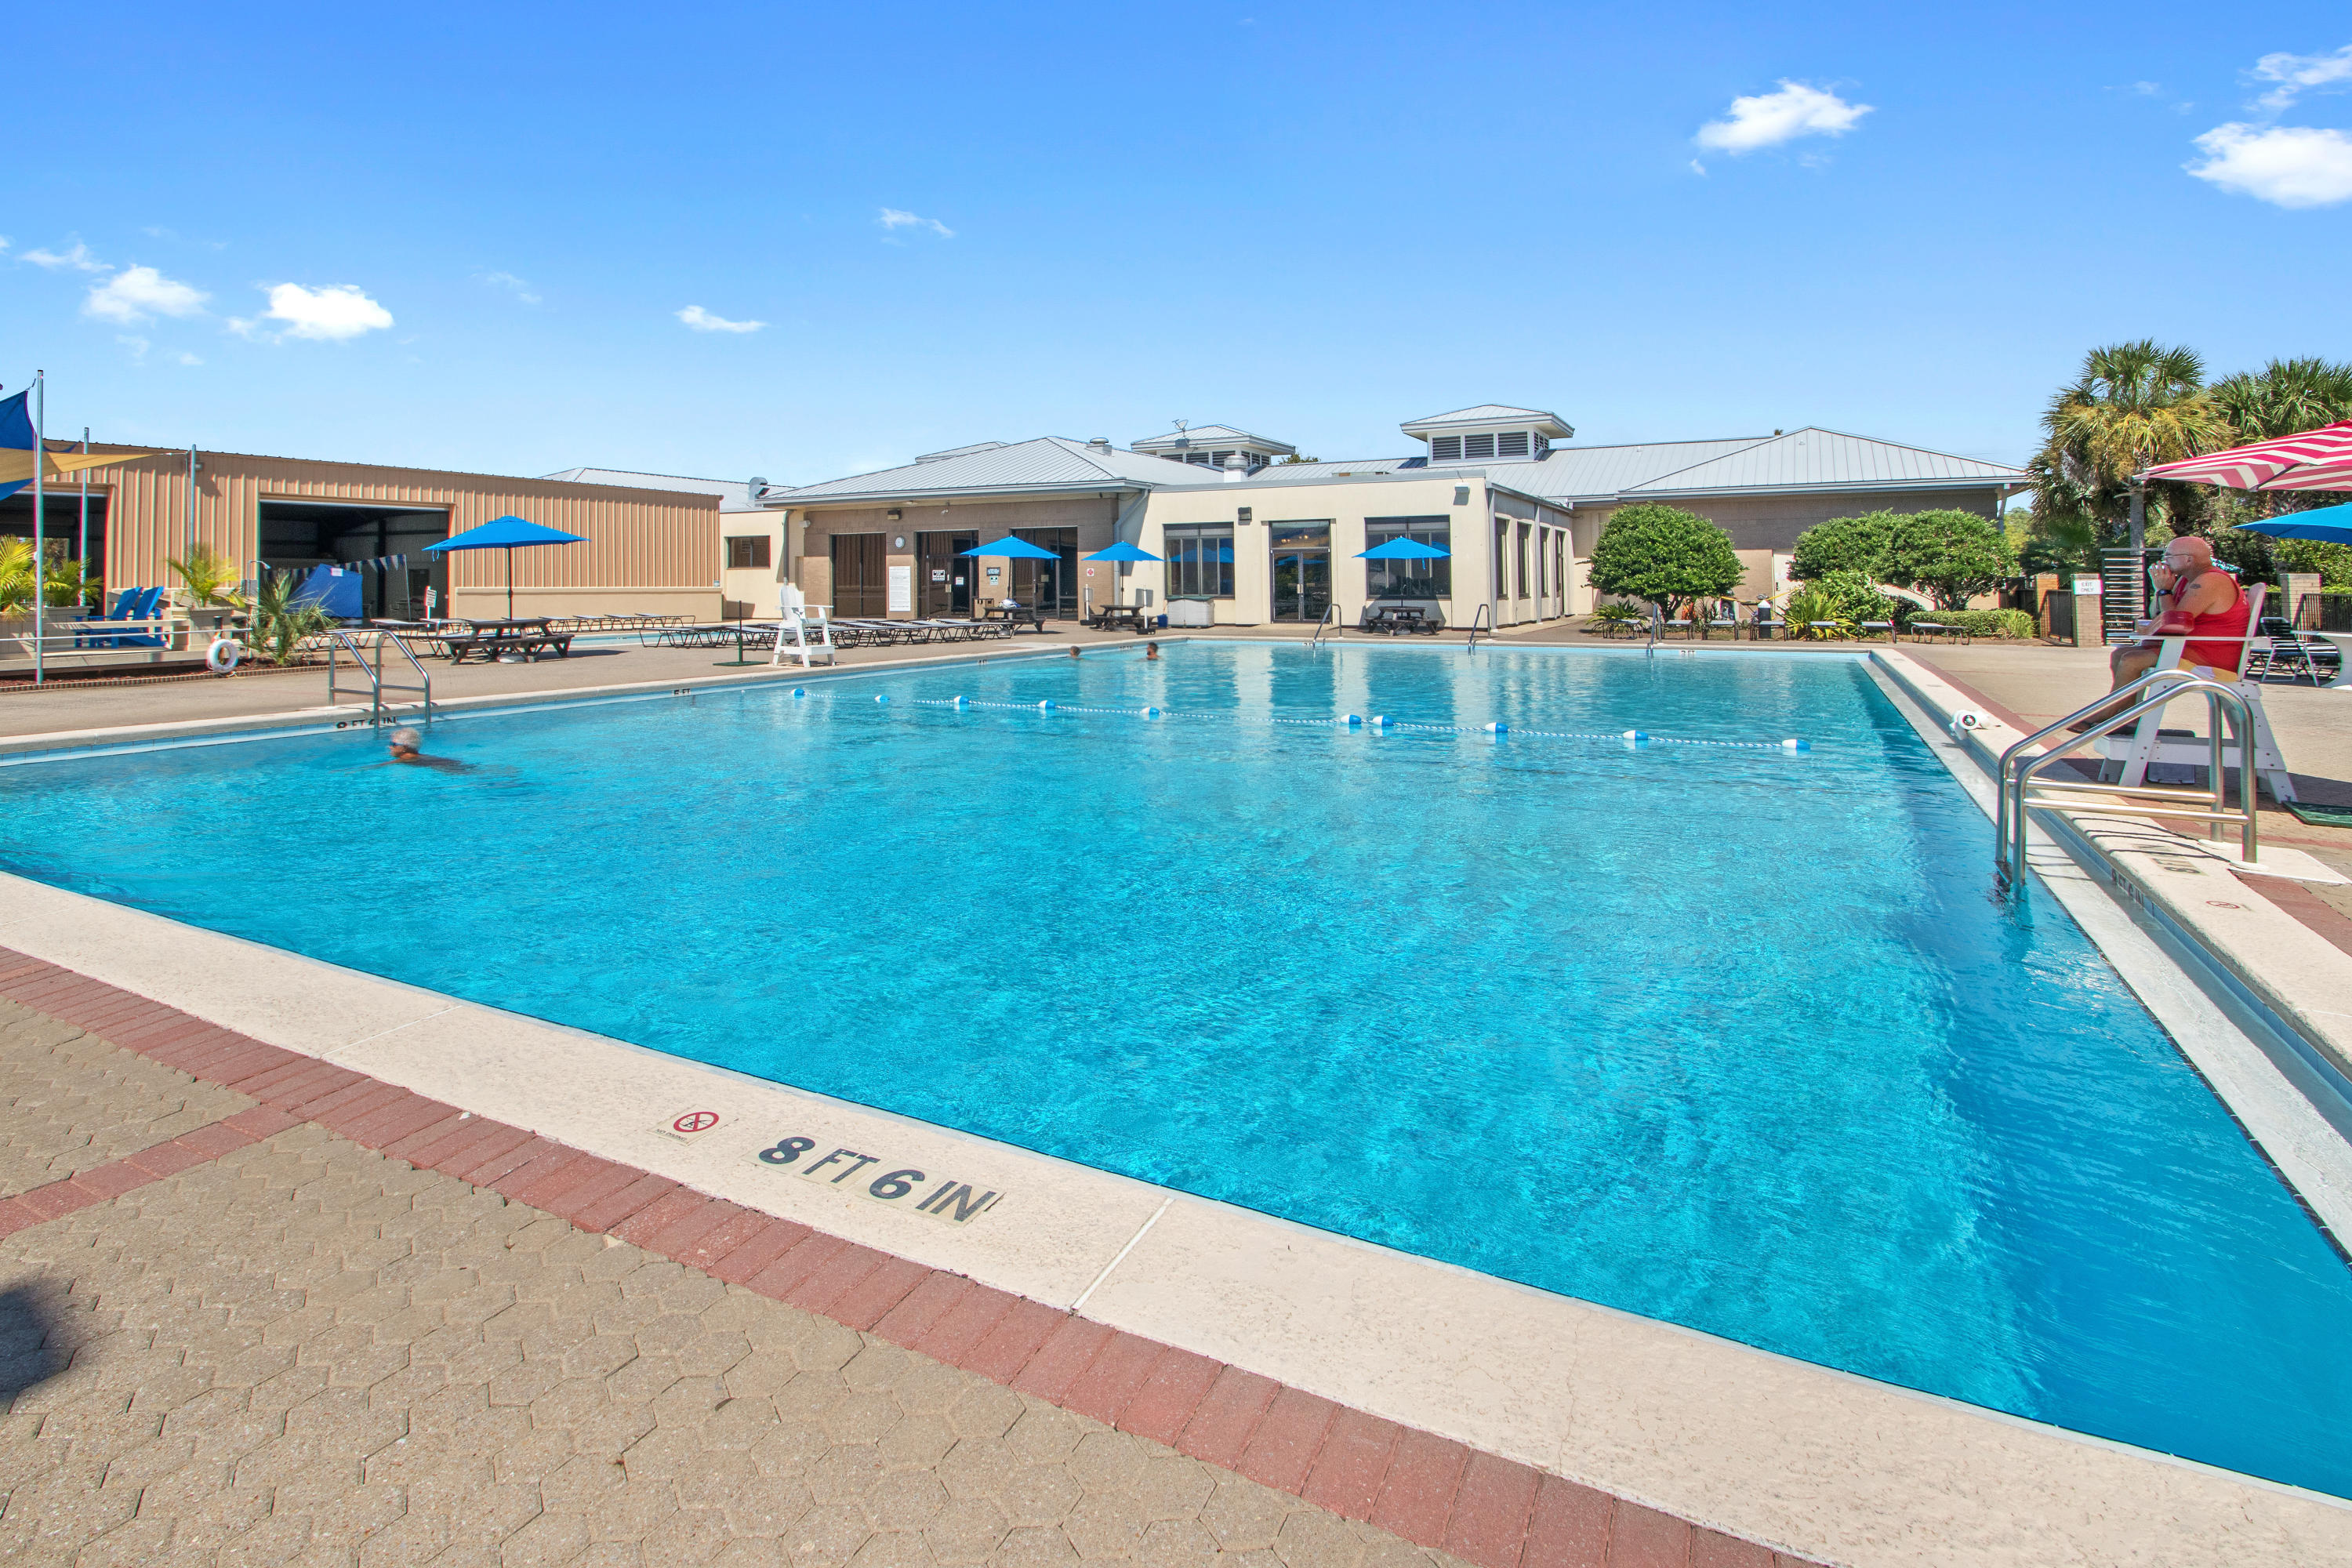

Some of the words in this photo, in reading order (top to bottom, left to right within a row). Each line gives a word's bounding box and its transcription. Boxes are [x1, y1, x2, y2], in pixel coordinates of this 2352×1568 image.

[666, 1131, 688, 1142] DIVING
[758, 1136, 816, 1165] 8
[801, 1148, 881, 1184] FT
[869, 1169, 926, 1200] 6
[915, 1180, 997, 1222] IN
